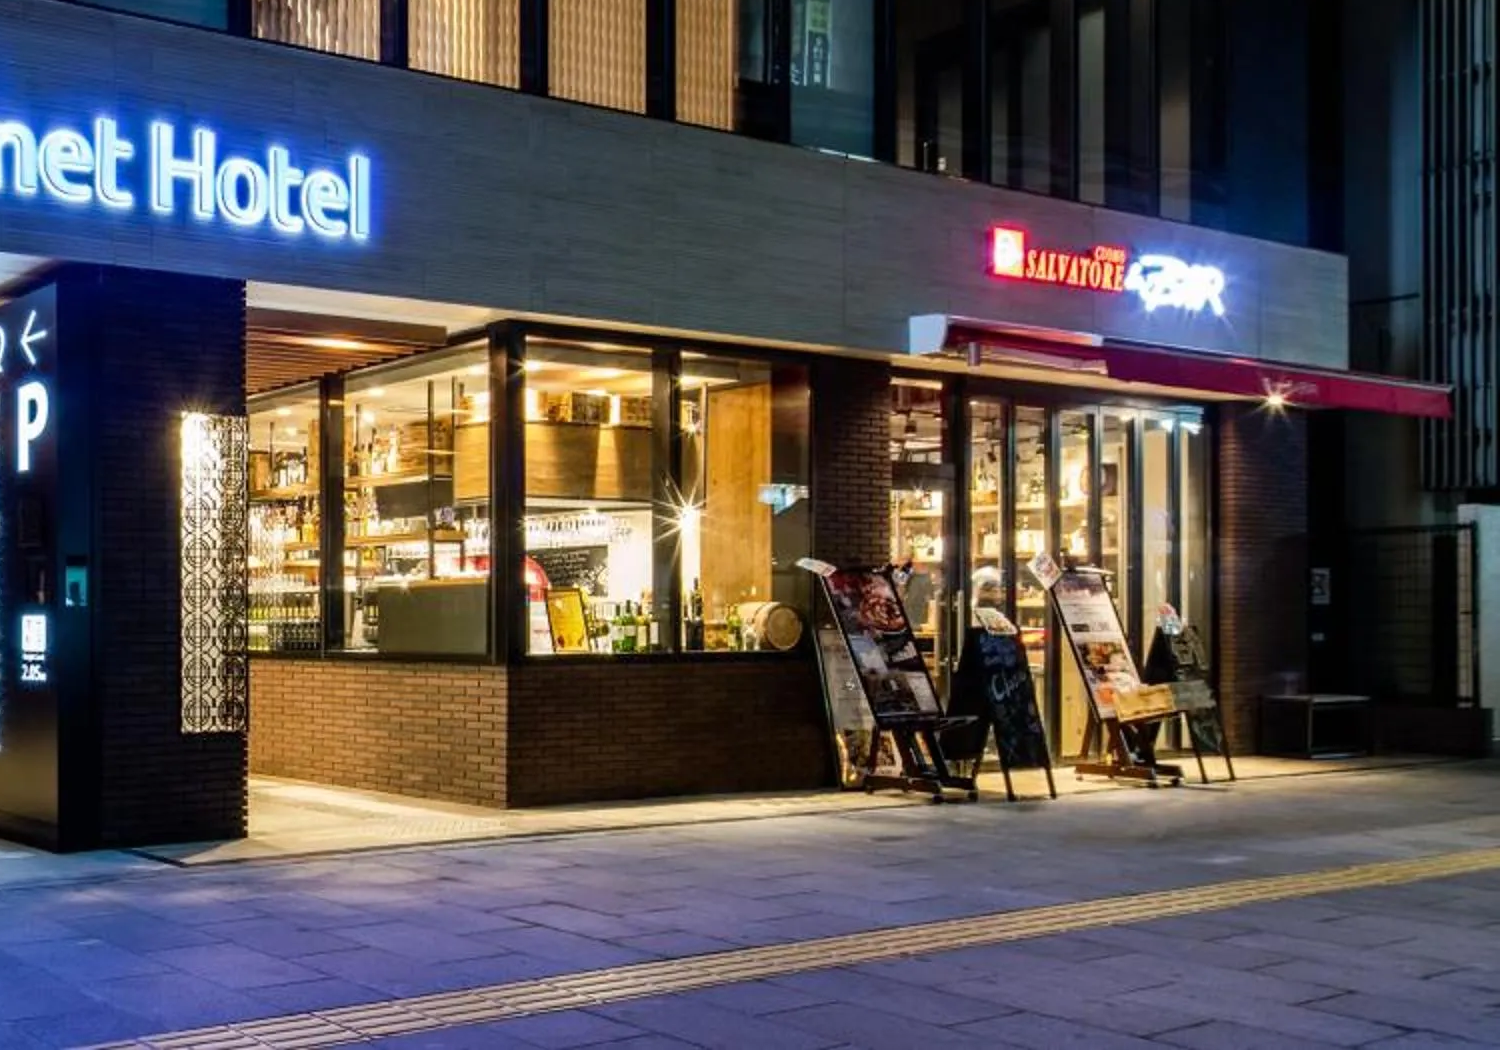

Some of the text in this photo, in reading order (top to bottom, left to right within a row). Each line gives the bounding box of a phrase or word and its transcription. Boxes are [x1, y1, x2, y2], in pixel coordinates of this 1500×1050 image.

[151, 121, 372, 238] Hotel
[1025, 249, 1124, 291] SALVATORE
[16, 382, 49, 473] P
